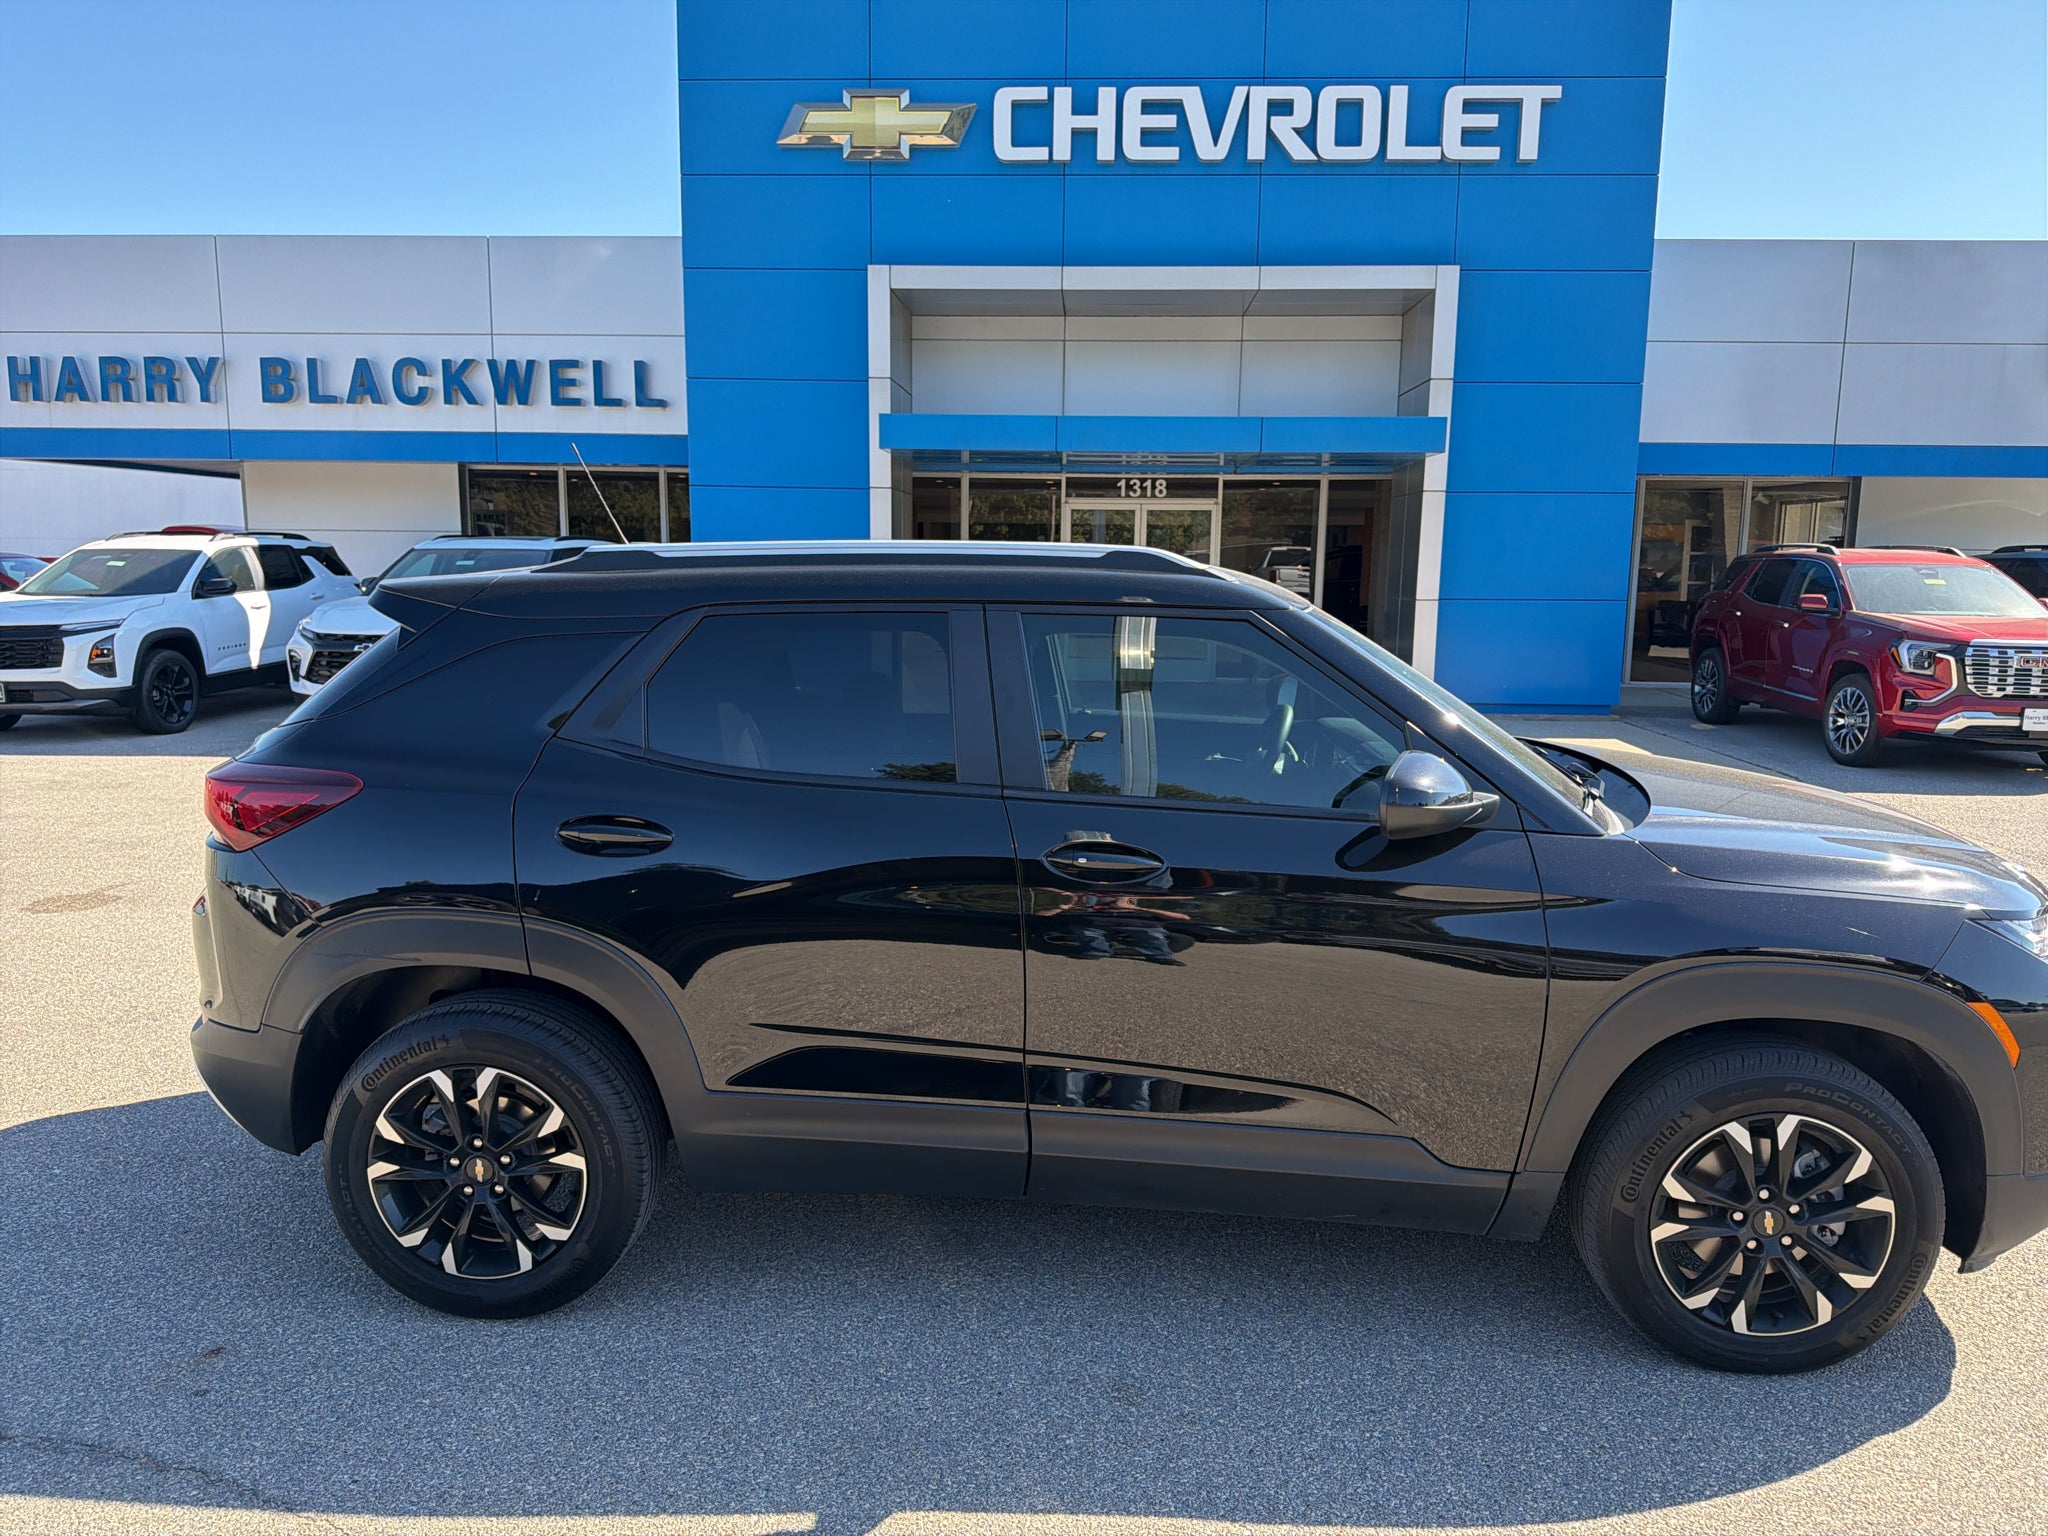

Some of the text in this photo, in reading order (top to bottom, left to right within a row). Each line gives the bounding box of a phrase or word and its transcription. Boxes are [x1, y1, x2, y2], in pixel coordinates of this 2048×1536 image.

[993, 84, 1563, 163] CHEVROLET
[6, 355, 669, 409] HARRY BLACKWELL
[1116, 478, 1168, 498] 1318
[362, 1036, 438, 1093] Continental
[1621, 1117, 1683, 1203] Continental
[1865, 1253, 1928, 1334] Continental
